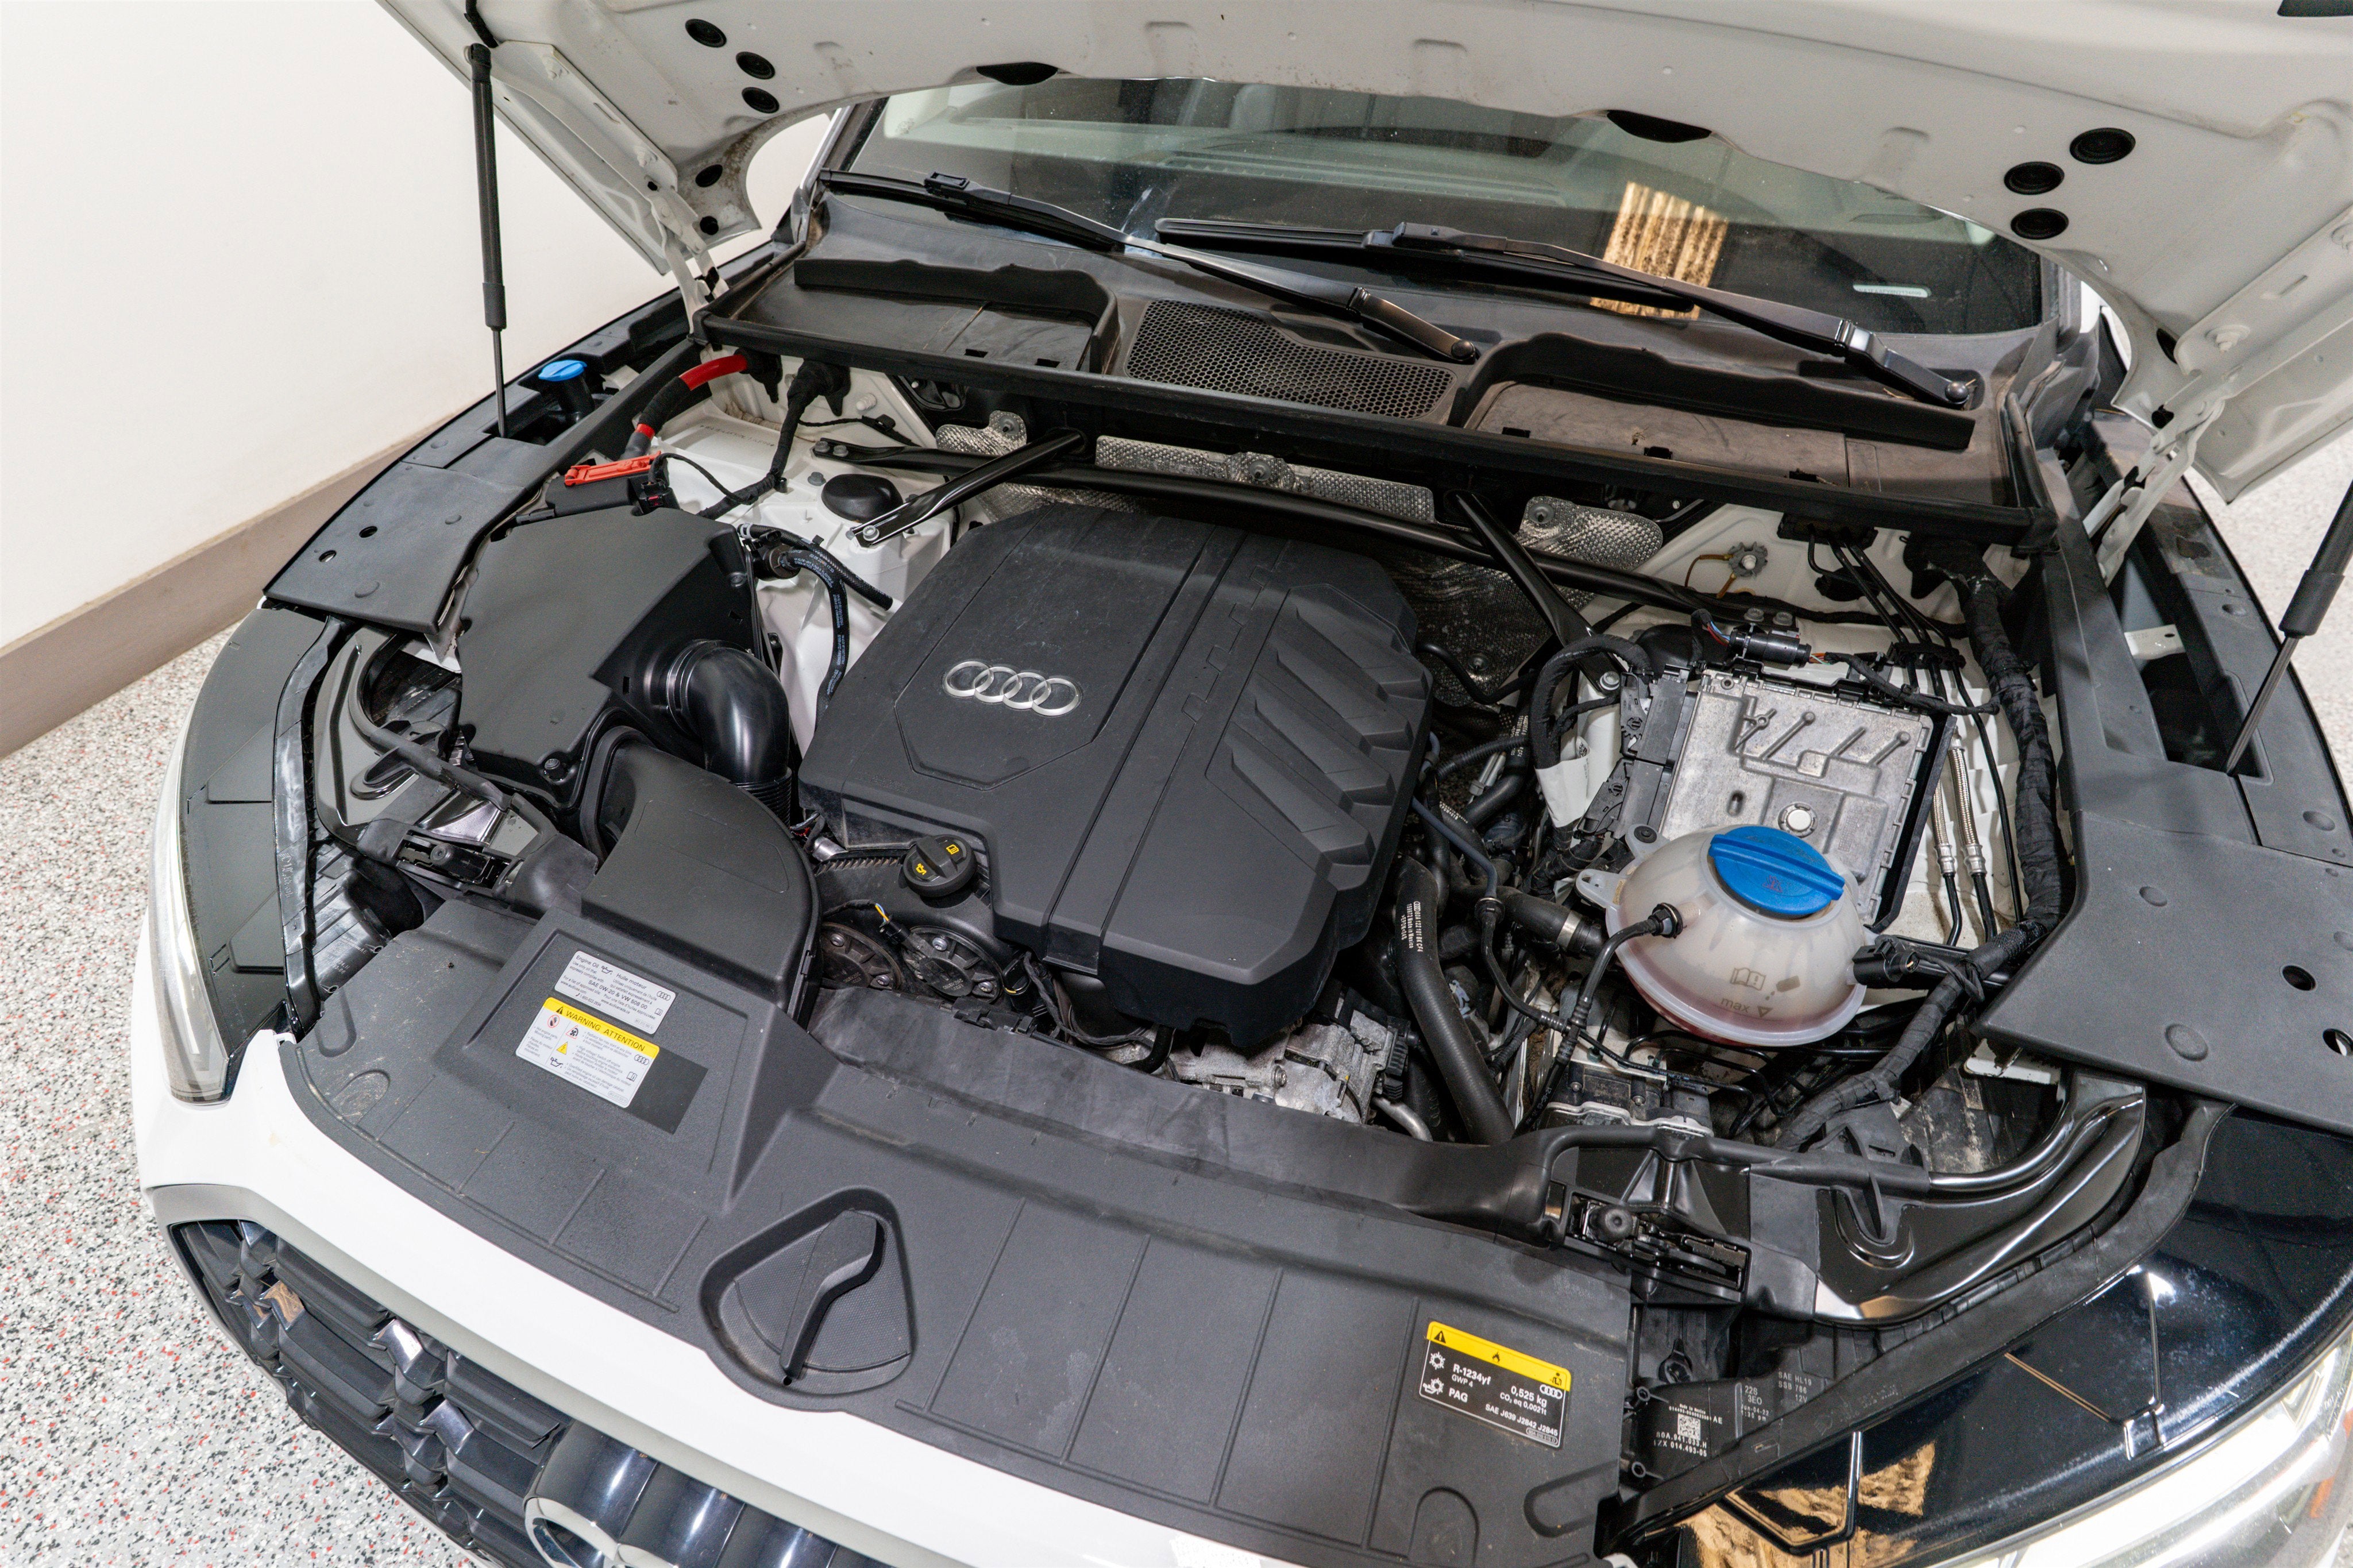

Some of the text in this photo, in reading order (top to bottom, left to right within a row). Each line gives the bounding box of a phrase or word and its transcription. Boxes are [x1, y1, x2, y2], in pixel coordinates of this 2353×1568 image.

[574, 954, 592, 966] Engine
[615, 972, 647, 990] Huile moteur
[587, 979, 599, 988] SAE
[598, 984, 615, 995] 0W-20
[620, 994, 631, 1002] VW
[630, 998, 641, 1006] 508
[1721, 998, 1751, 1013] max
[564, 1009, 646, 1052] WARNING ATTENTION
[1450, 1373, 1475, 1388] GWP 4
[1451, 1363, 1492, 1387] R-1234yf
[1778, 1370, 1812, 1386] SAE HL19
[1446, 1387, 1469, 1403] PAG
[1509, 1385, 1549, 1408] 0,525 kg
[1745, 1385, 1758, 1396] 22S
[1795, 1394, 1807, 1403] 12V
[1512, 1397, 1523, 1407] eq
[1484, 1403, 1559, 1436] SAE J639 J2842 J2845
[1713, 1415, 1723, 1424] AE
